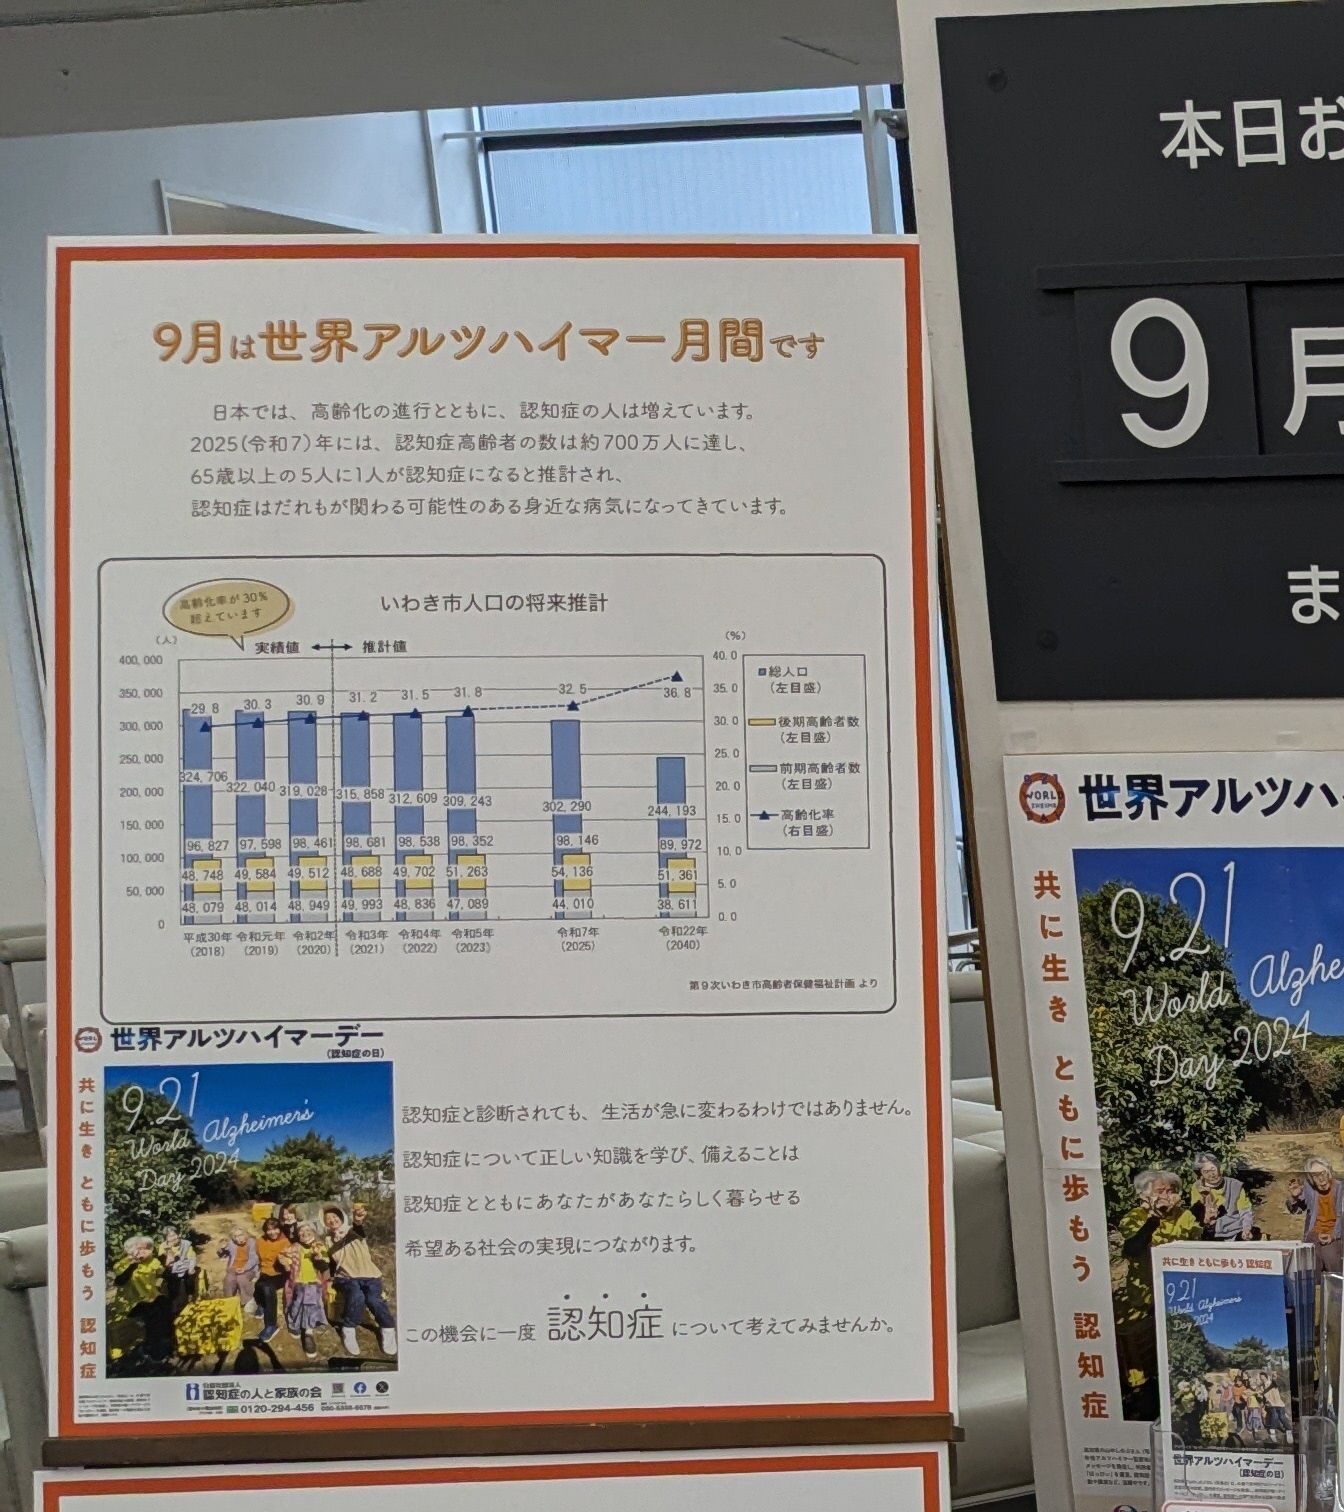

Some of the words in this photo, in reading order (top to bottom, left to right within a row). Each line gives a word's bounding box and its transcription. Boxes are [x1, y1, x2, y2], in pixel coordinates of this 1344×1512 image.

[151, 317, 826, 365] 9月は世界アルツハイマー月間です
[380, 591, 609, 616] いわき市人口の将来推計
[255, 641, 300, 654] 実績値
[362, 640, 407, 654] 推計値
[768, 666, 808, 678] 総人口
[401, 689, 429, 700] 31.5
[454, 686, 482, 697] 31.8
[558, 683, 587, 695] 32.5
[663, 687, 691, 698] 36.8
[296, 694, 324, 706] 30.9
[349, 691, 377, 703] 31.2
[191, 703, 219, 714] 29.8
[244, 699, 272, 710] 30.3
[778, 715, 859, 728] 後期高齢者数
[780, 762, 860, 775] 前期高齢者数
[180, 771, 228, 782] 324,706
[227, 781, 275, 793] 322,040
[336, 788, 384, 800] 315,858
[443, 795, 492, 806] 309,243
[542, 801, 591, 812] 302,290
[648, 805, 696, 817] 244,193
[781, 808, 834, 821] 高齢化率
[1109, 860, 1236, 973] 9.21
[859, 979, 878, 989] より
[1125, 971, 1231, 1028] World
[111, 1024, 384, 1052] 世界アルツハイマーデー
[1149, 1043, 1223, 1090] Day
[1232, 1010, 1312, 1070] 2024
[122, 1072, 200, 1133] 9.21
[78, 1078, 96, 1159] 共に生き
[124, 1130, 191, 1160] World
[1033, 869, 1069, 1024] 共に生き
[1053, 1054, 1092, 1282] ともに歩もう
[1073, 1311, 1109, 1420] 認知症
[403, 1145, 799, 1169] 認知症について正しい知識を学び、備えることは
[139, 1168, 186, 1194] Day
[189, 1152, 240, 1180] 2024
[404, 1189, 801, 1213] 認知症とともにあなたがあなたらしく暮らせる
[80, 1176, 96, 1300] ともに歩もう
[404, 1236, 697, 1258] 希望ある社会の実現につながります。
[406, 1323, 536, 1343] この機会に一度
[547, 1304, 664, 1341] 認知症
[672, 1316, 896, 1336] について考えてみませんか。
[79, 1318, 97, 1379] 認知症
[241, 1404, 314, 1413] 0120-294-456
